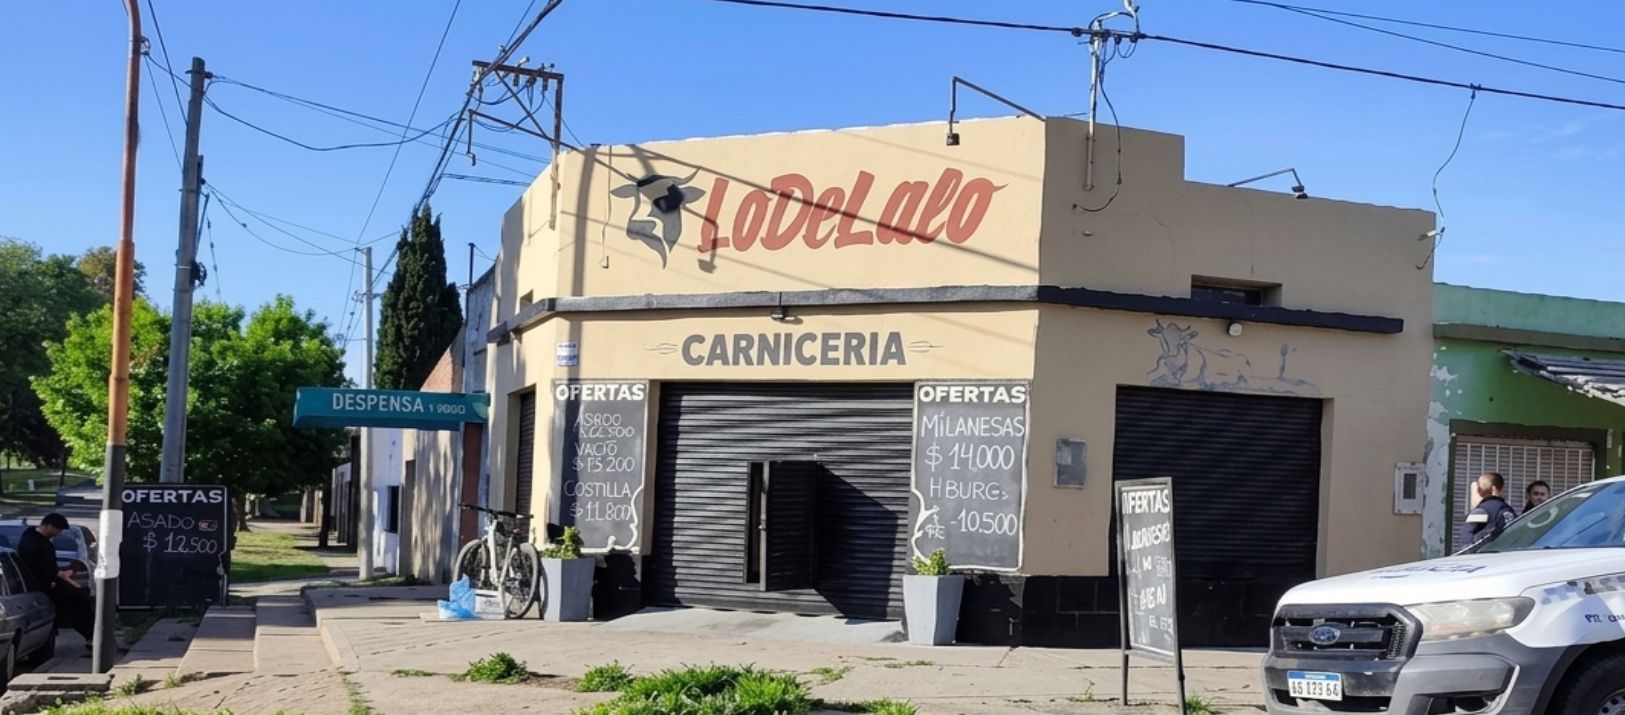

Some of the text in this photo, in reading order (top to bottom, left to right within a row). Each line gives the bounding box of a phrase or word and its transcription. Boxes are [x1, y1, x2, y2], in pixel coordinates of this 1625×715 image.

[681, 332, 907, 366] CARNICERIA
[555, 383, 645, 401] OFERTAS
[919, 386, 1027, 404] OFERTAS
[332, 392, 424, 413] DESPENSA
[121, 489, 223, 503] OFERTAS
[564, 480, 632, 498] COSTILLA
[127, 511, 195, 530] ASADO
